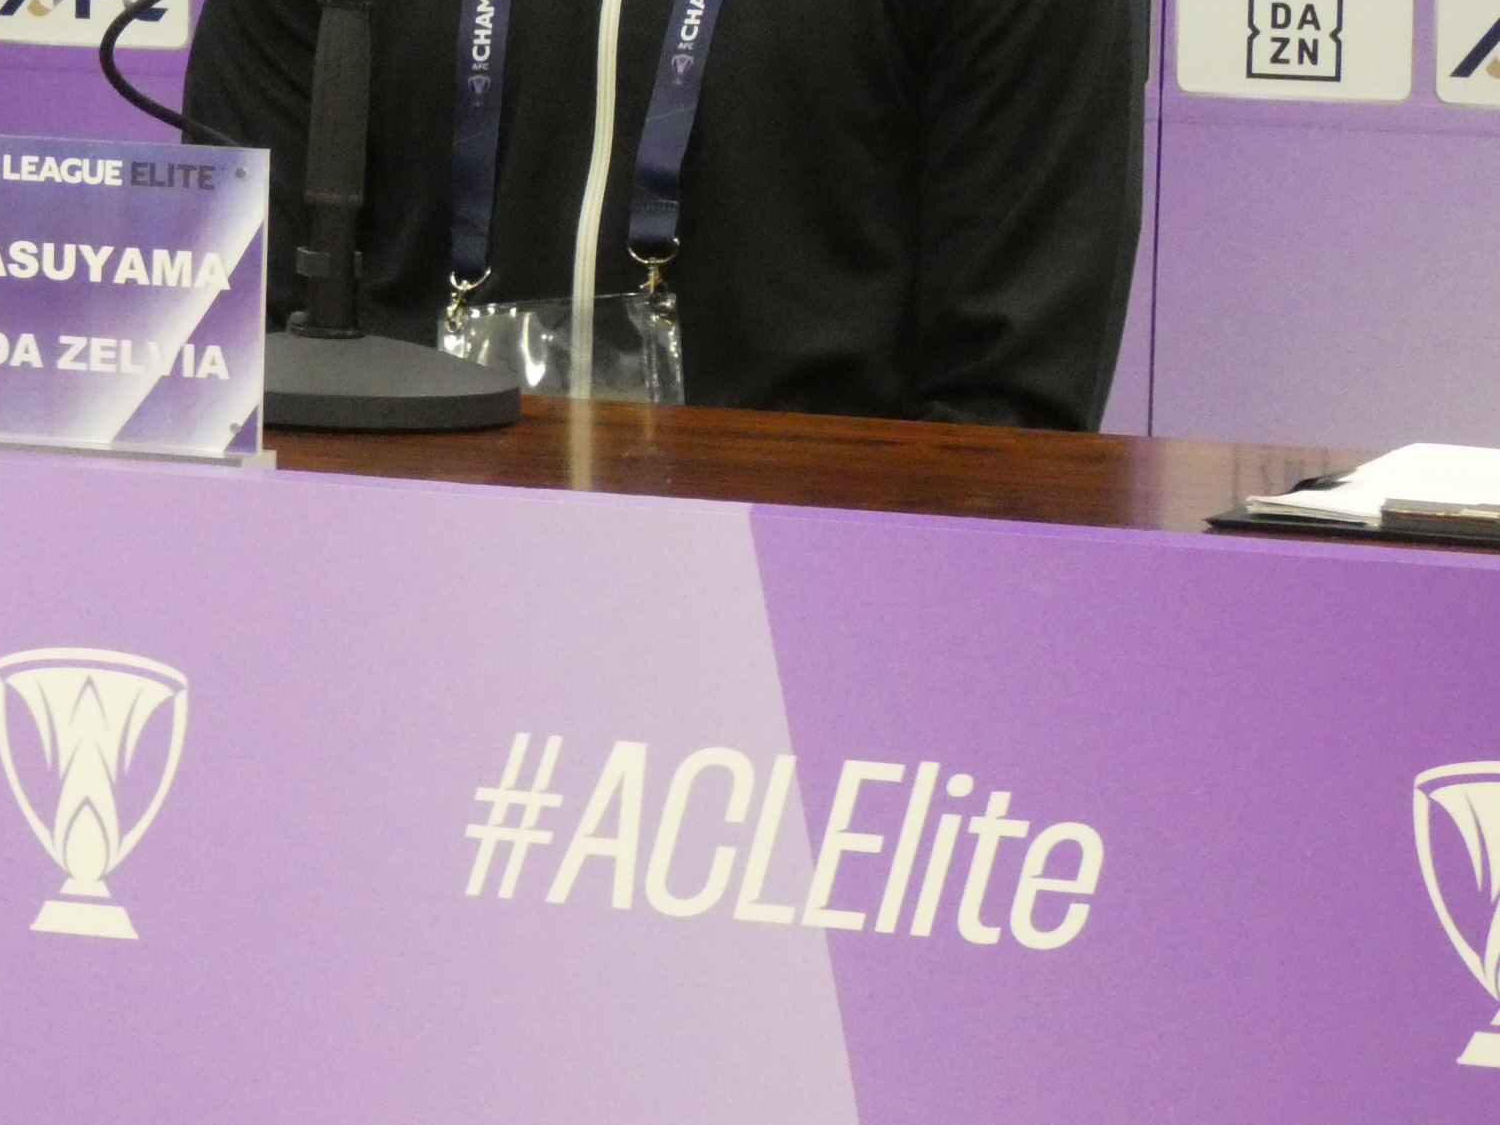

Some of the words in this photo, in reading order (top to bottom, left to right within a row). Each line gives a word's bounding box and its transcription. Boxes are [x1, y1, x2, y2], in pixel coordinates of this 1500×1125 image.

[678, 42, 694, 50] AFC
[472, 63, 489, 71] AFC
[3, 154, 123, 186] LEAGUE
[130, 161, 216, 191] ELITE
[464, 732, 1105, 950] #ACLElite
